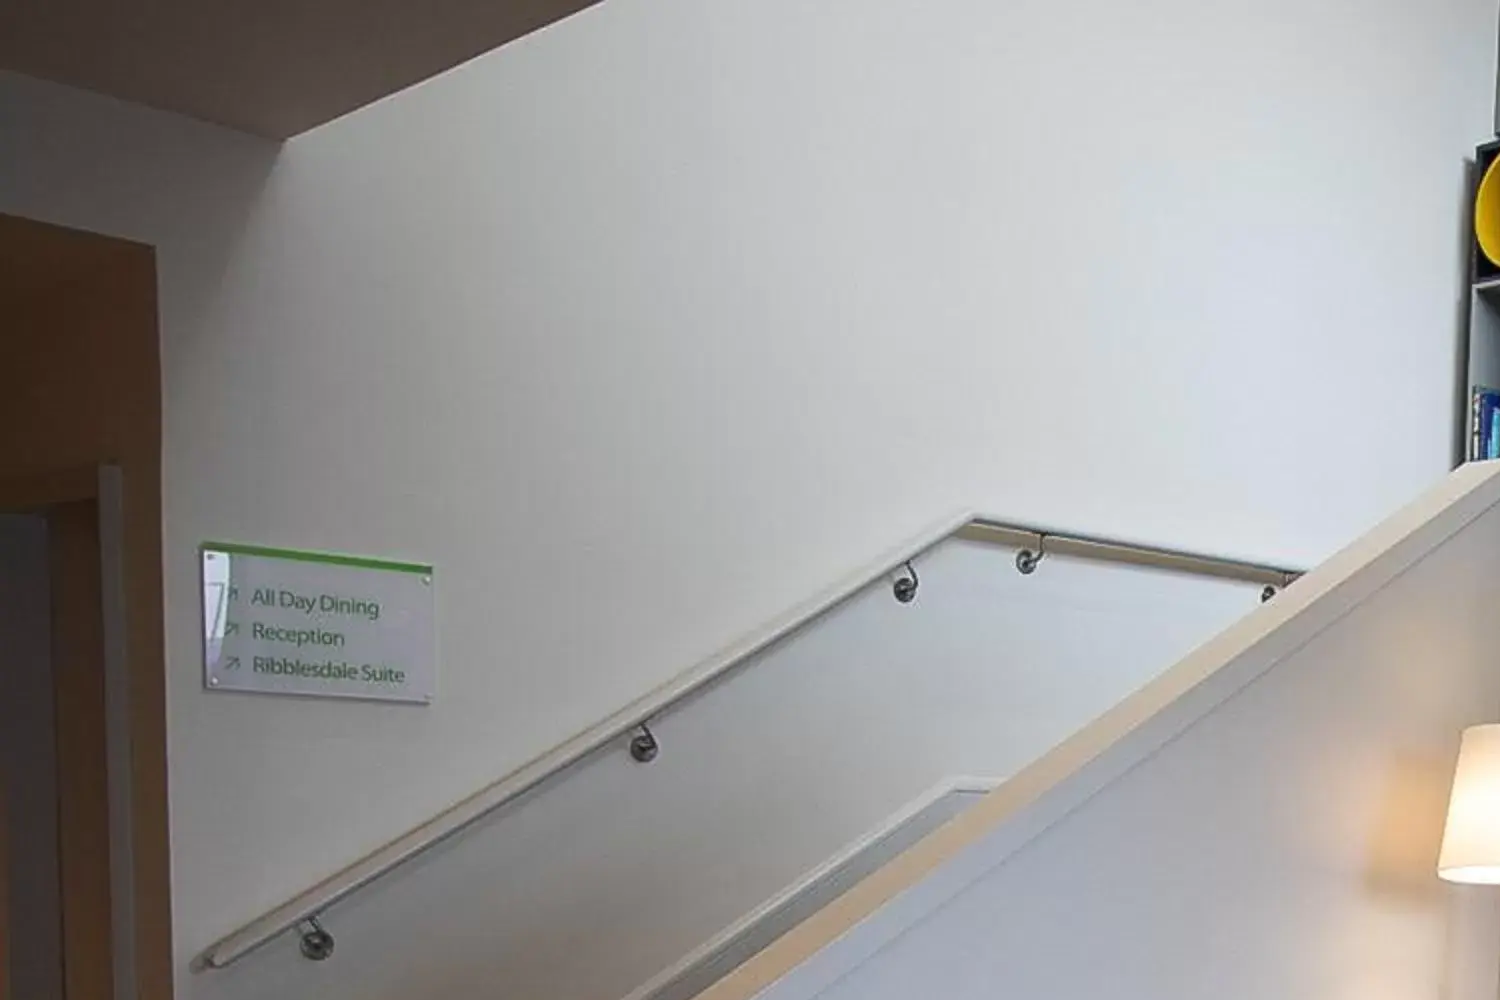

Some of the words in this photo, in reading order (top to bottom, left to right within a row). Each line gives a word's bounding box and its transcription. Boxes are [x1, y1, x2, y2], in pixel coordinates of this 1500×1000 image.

[251, 588, 275, 607] All
[279, 591, 316, 613] Day
[320, 594, 380, 621] Dining
[252, 622, 345, 647] Reception
[252, 656, 358, 681] Ribblesdale
[361, 663, 406, 684] Suite
